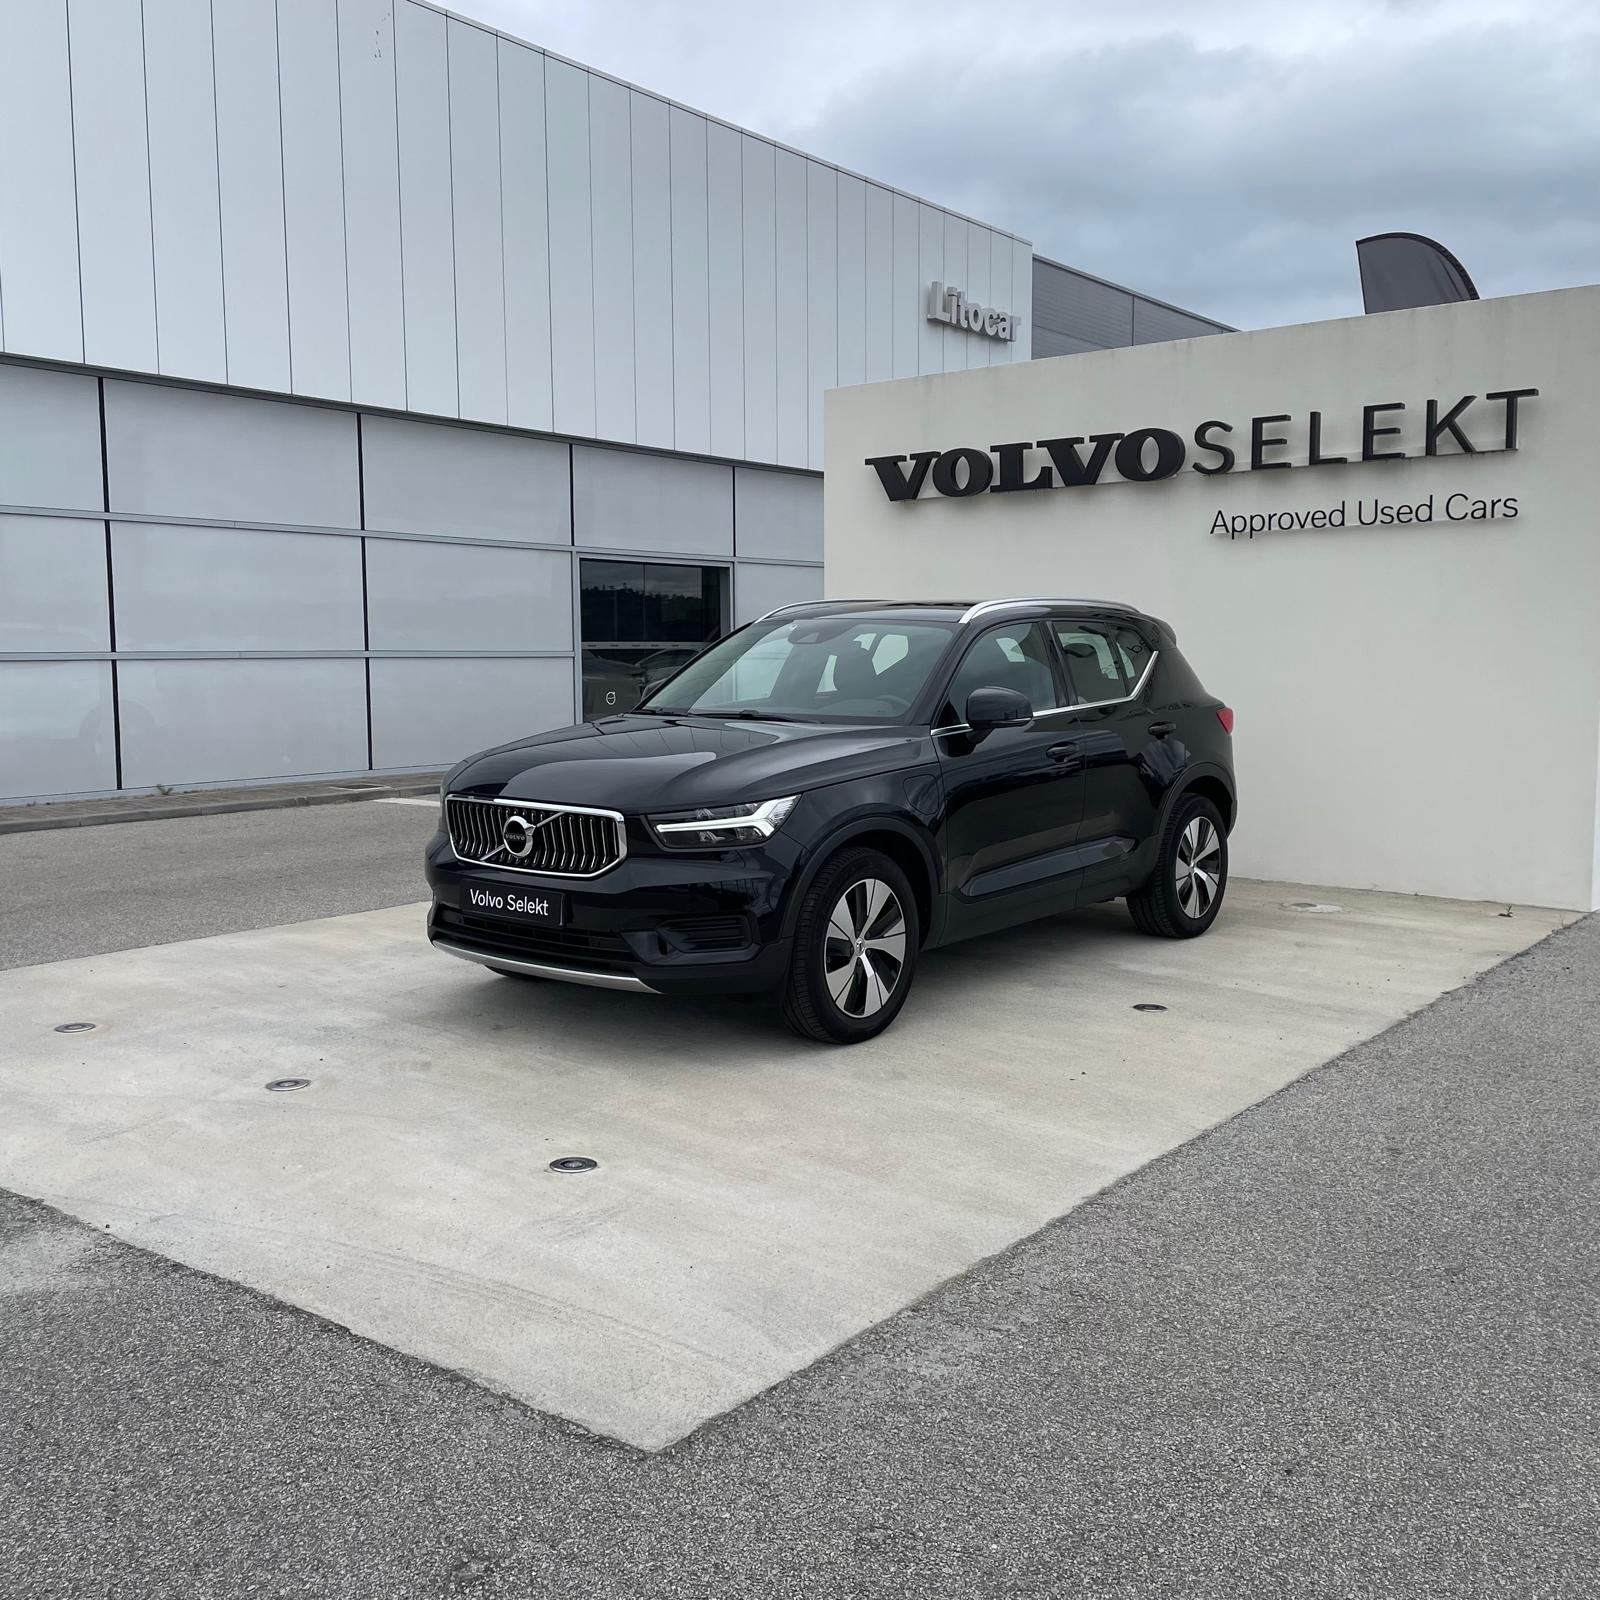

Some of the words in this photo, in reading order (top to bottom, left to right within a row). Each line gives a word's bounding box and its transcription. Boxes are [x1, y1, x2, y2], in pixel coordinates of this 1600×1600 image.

[926, 281, 1021, 342] Litocar
[865, 427, 1186, 502] VOLVO
[1192, 389, 1538, 475] SELEKT
[1210, 501, 1346, 540] Approved
[1358, 494, 1434, 526] Used
[1445, 493, 1519, 521] Cars
[505, 833, 526, 841] VOLVO
[470, 888, 504, 909] Volvo
[506, 894, 549, 916] Selekt
